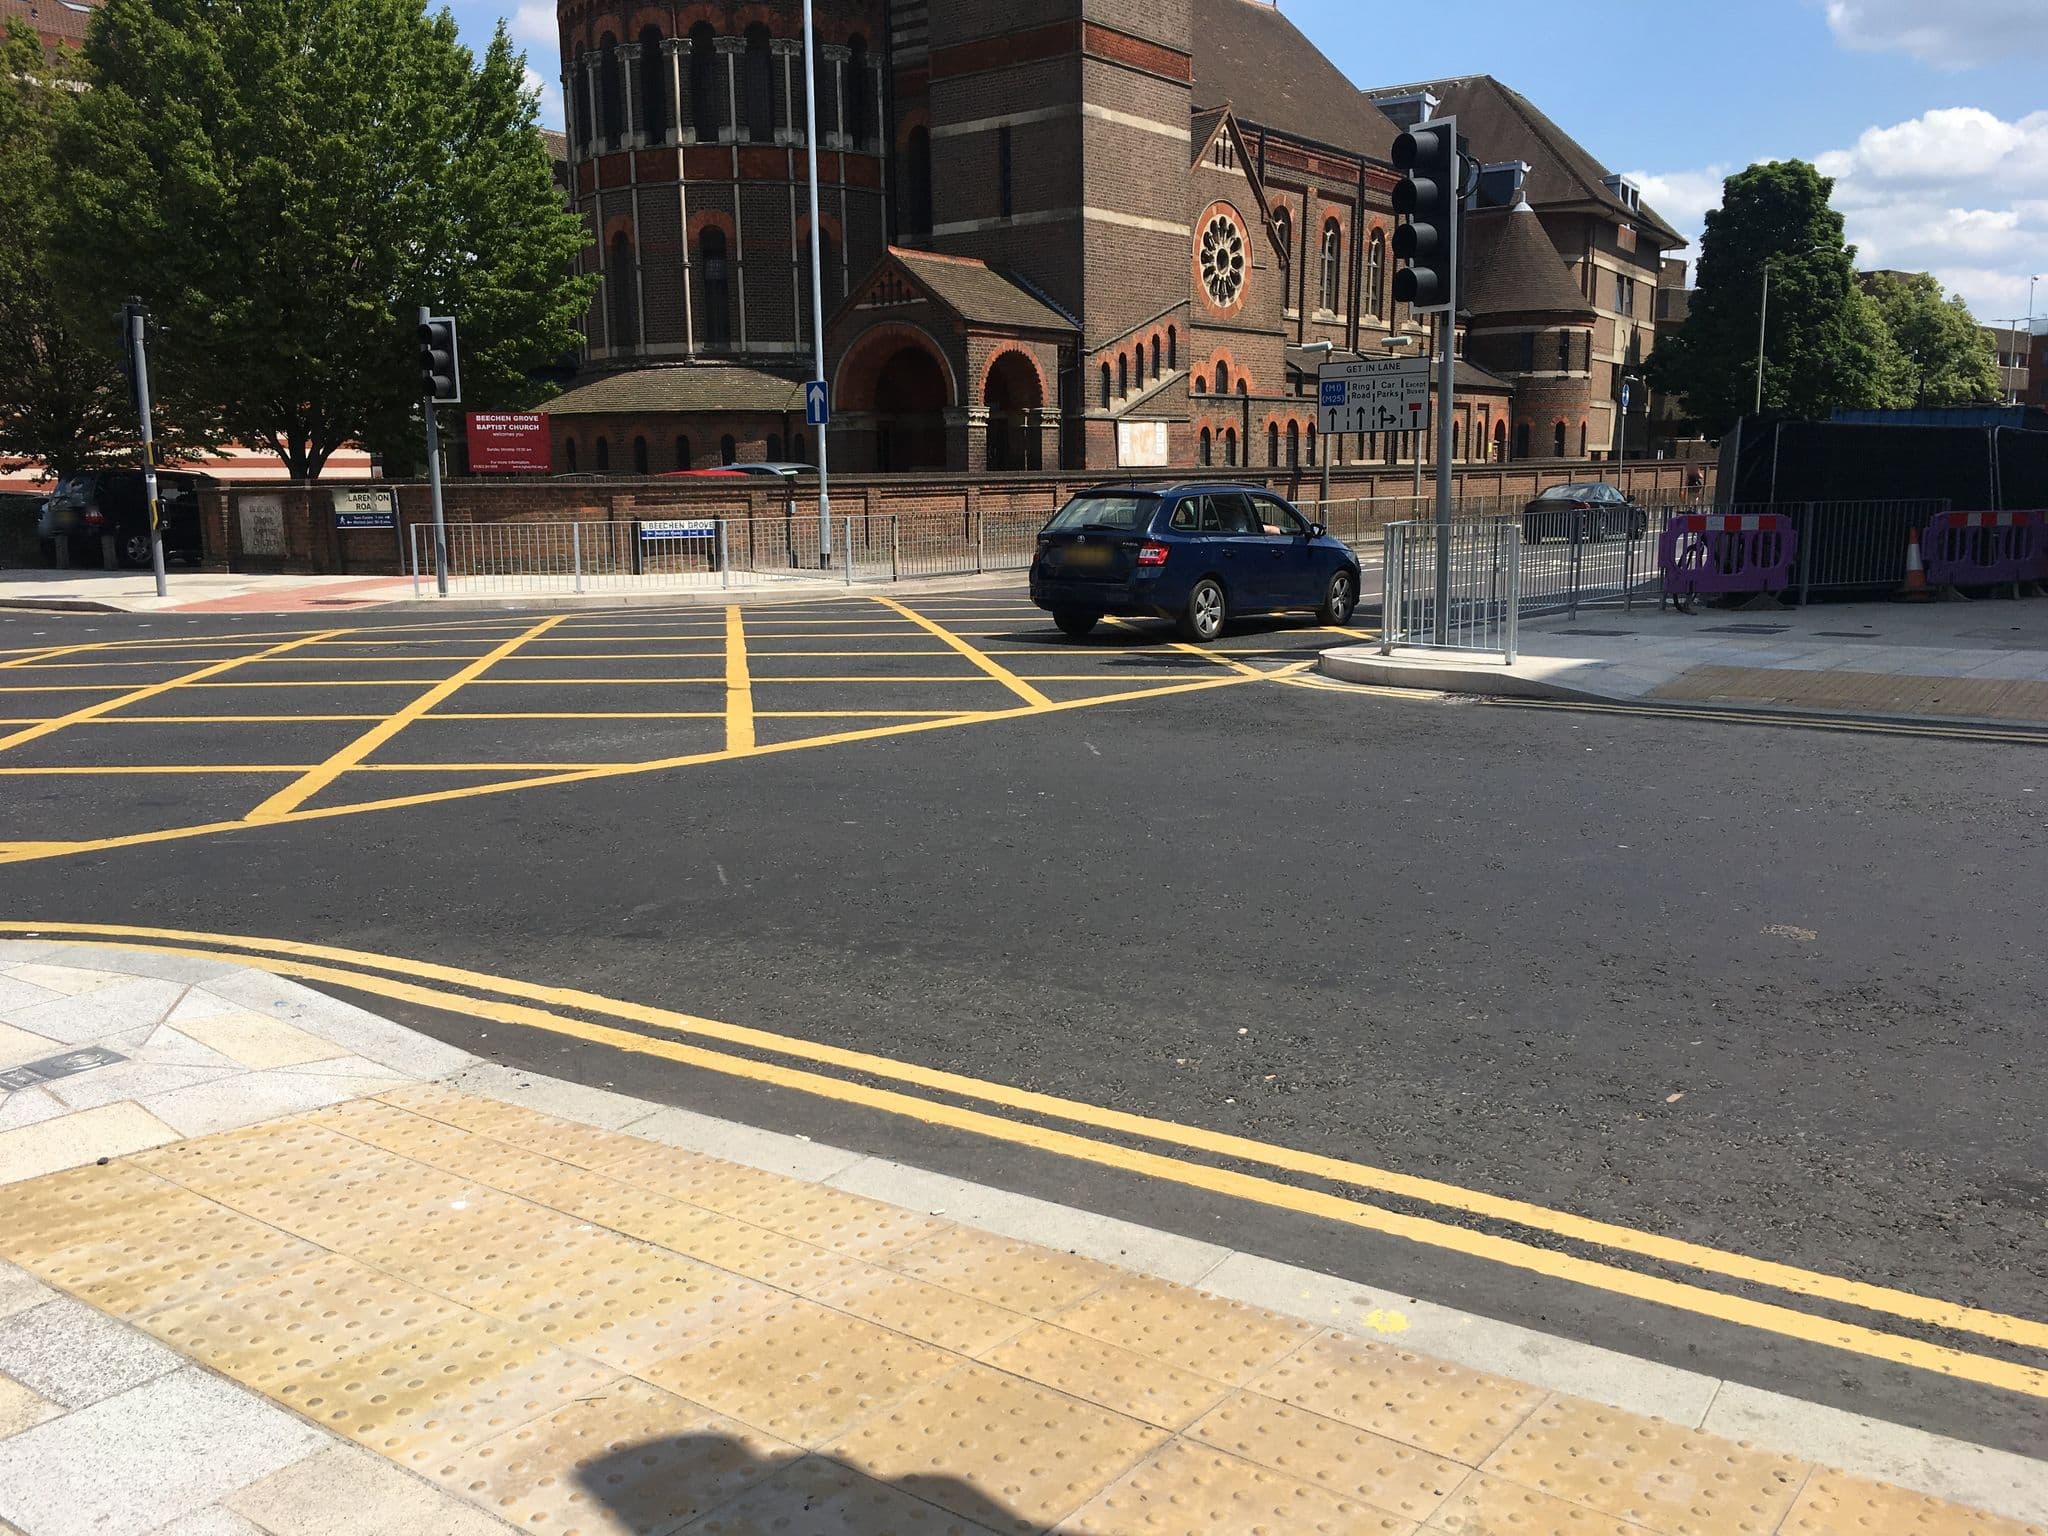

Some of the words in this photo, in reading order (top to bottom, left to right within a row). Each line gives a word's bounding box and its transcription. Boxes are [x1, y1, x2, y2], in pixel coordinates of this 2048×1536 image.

[1346, 365, 1363, 373] GET
[1366, 364, 1375, 372] IN
[1378, 362, 1401, 371] LANE
[1324, 383, 1342, 392] (M1)
[1352, 383, 1370, 391] Ring
[1381, 381, 1396, 389] Car
[1351, 391, 1371, 399] Road
[1376, 390, 1399, 398] Parks
[1322, 394, 1345, 404] (M25)
[345, 494, 389, 502] LARENON
[648, 522, 684, 530] BEECHEN
[688, 521, 713, 529] GROVE
